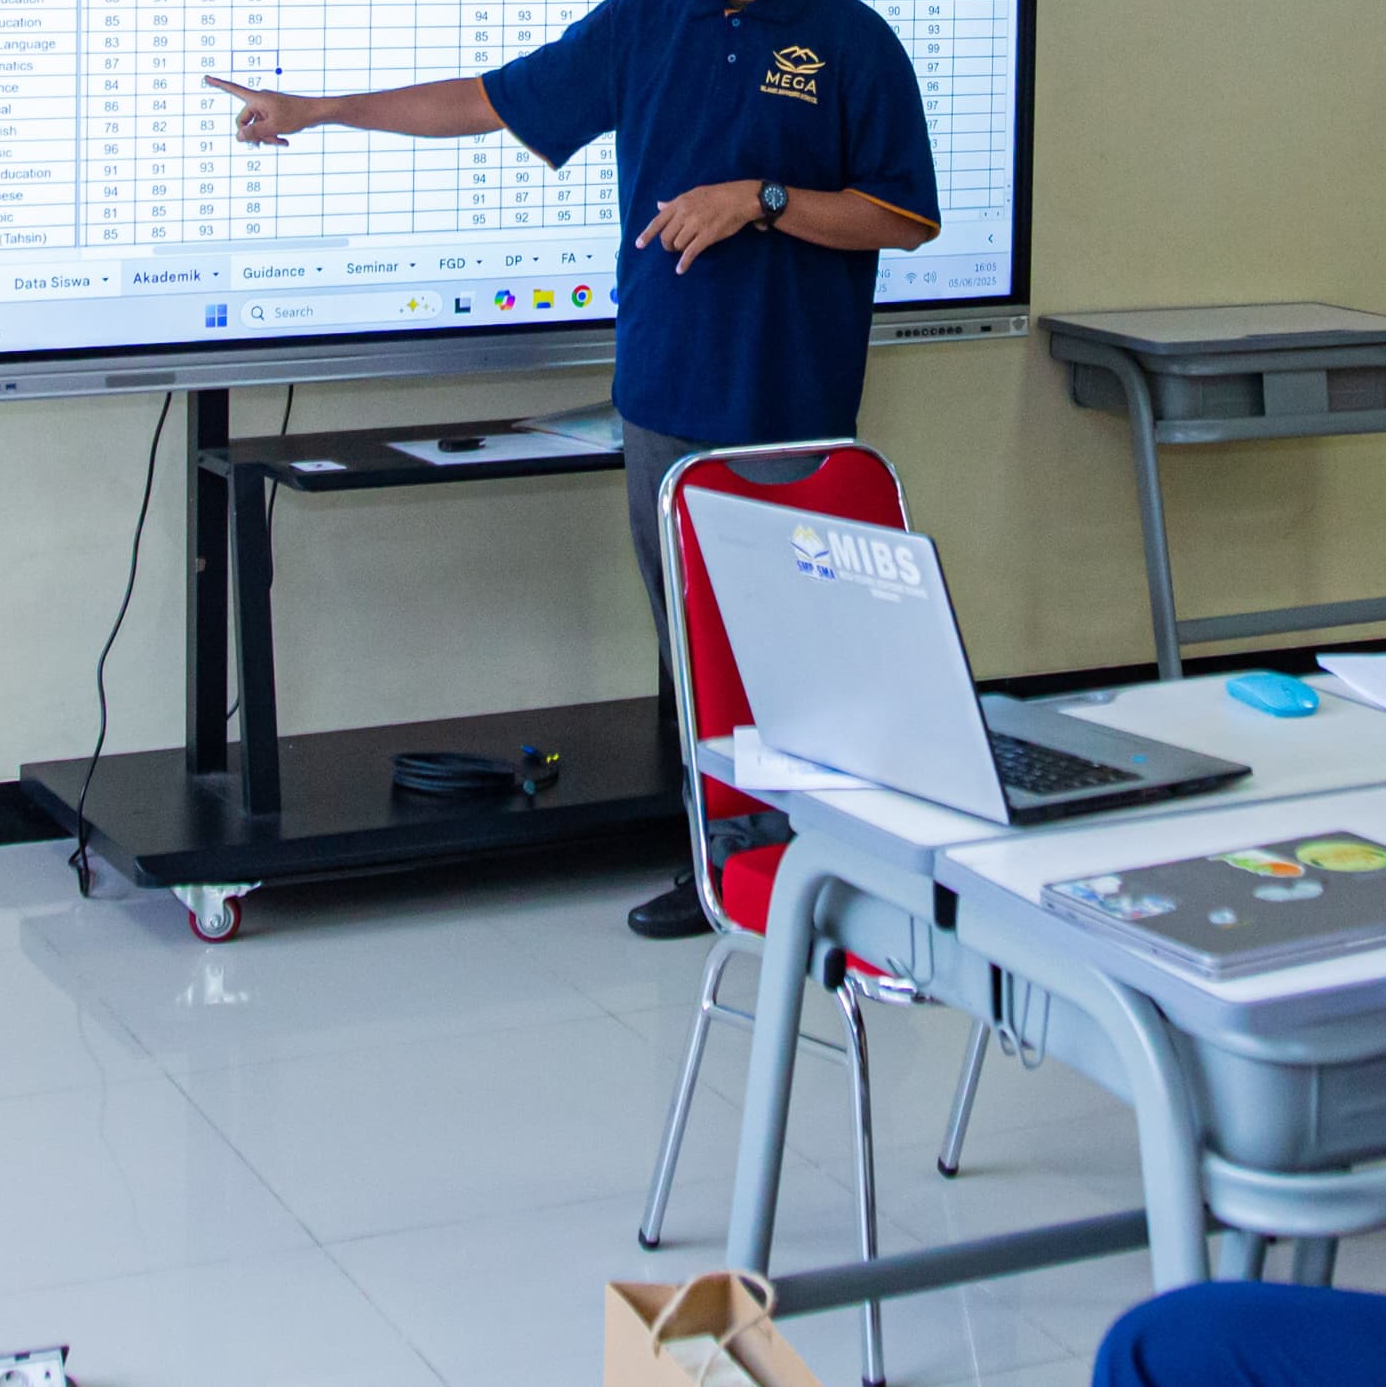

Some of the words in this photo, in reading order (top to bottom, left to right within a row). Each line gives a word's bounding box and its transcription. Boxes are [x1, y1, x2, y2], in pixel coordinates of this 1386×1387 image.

[928, 6, 940, 15] 94
[105, 16, 120, 27] 85
[153, 15, 168, 26] 89
[248, 14, 262, 25] 89
[928, 25, 940, 34] 93
[105, 37, 120, 48] 83
[153, 36, 168, 47] 89
[248, 35, 262, 46] 90
[928, 44, 940, 54] 99
[104, 58, 119, 69] 87
[153, 58, 166, 68] 91
[248, 56, 261, 67] 91
[927, 62, 939, 73] 97
[104, 80, 119, 90] 84
[153, 79, 167, 90] 86
[765, 70, 817, 94] MEGA
[927, 81, 939, 92] 96
[104, 101, 119, 112] 86
[153, 100, 167, 111] 84
[104, 123, 119, 133] 78
[152, 122, 167, 132] 82
[104, 144, 118, 155] 96
[152, 143, 166, 153] 94
[104, 165, 118, 176] 91
[152, 164, 165, 175] 91
[103, 186, 118, 197] 94
[152, 185, 166, 196] 89
[103, 208, 117, 219] 81
[152, 206, 166, 217] 85
[103, 229, 118, 240] 85
[151, 228, 166, 238] 85
[0, 232, 47, 246] (Tahsin)
[439, 258, 466, 270] FGD
[505, 255, 522, 267] DP
[561, 253, 576, 264] FA
[243, 265, 305, 280] Guidance
[346, 261, 399, 275] Seminar
[14, 277, 47, 291] Data
[51, 275, 90, 289] Siswa
[133, 270, 201, 285] Akademik
[274, 306, 313, 319] Search
[827, 531, 921, 585] MIBS
